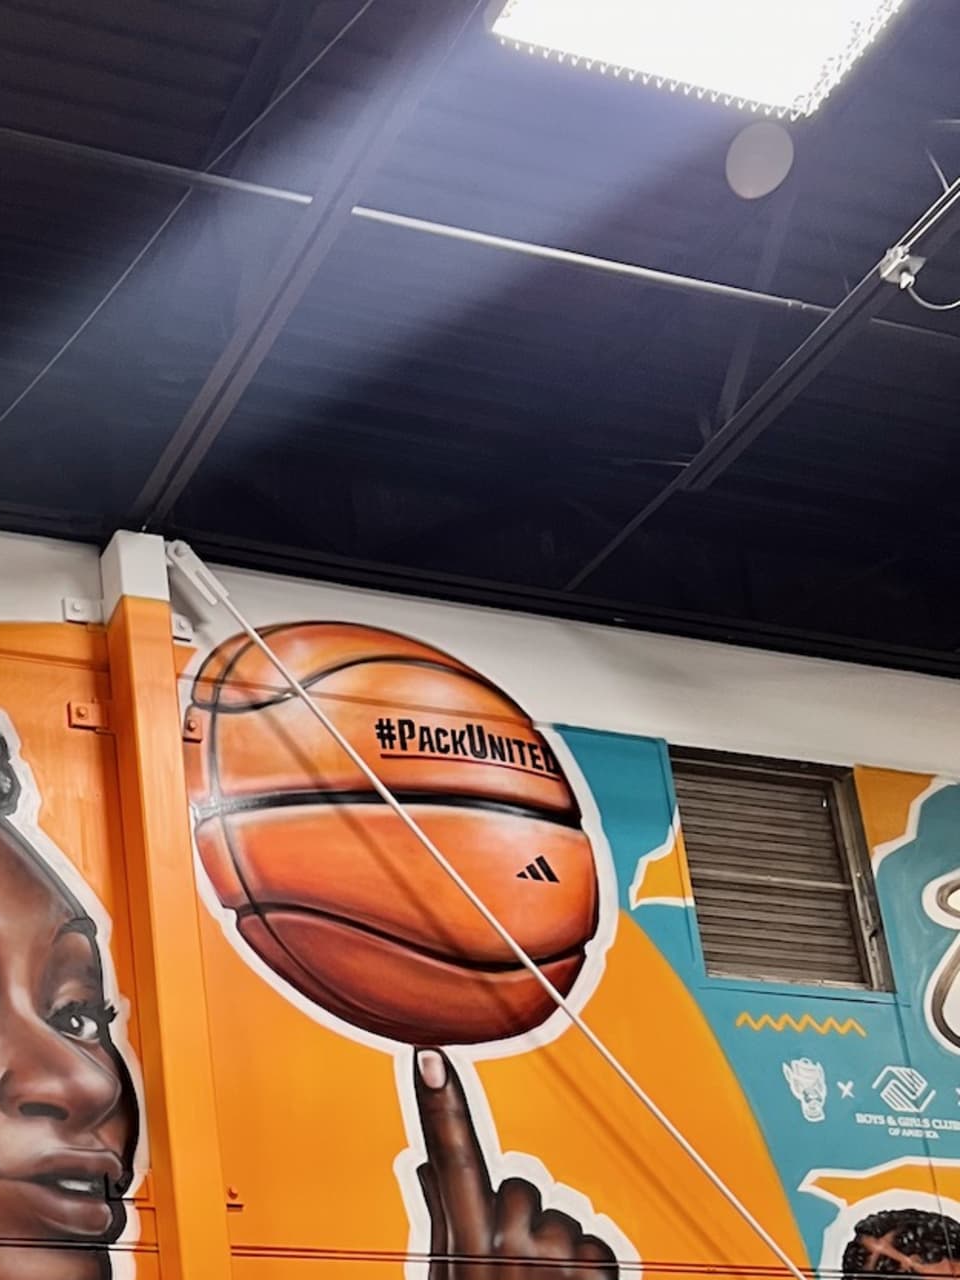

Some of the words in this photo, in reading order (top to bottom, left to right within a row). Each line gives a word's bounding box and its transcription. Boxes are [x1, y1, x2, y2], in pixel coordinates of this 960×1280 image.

[855, 1112, 886, 1125] BOYS
[886, 1115, 897, 1127] &
[897, 1116, 931, 1129] GIRLS
[888, 1127, 901, 1137] OF
[901, 1128, 940, 1139] AMERICA
